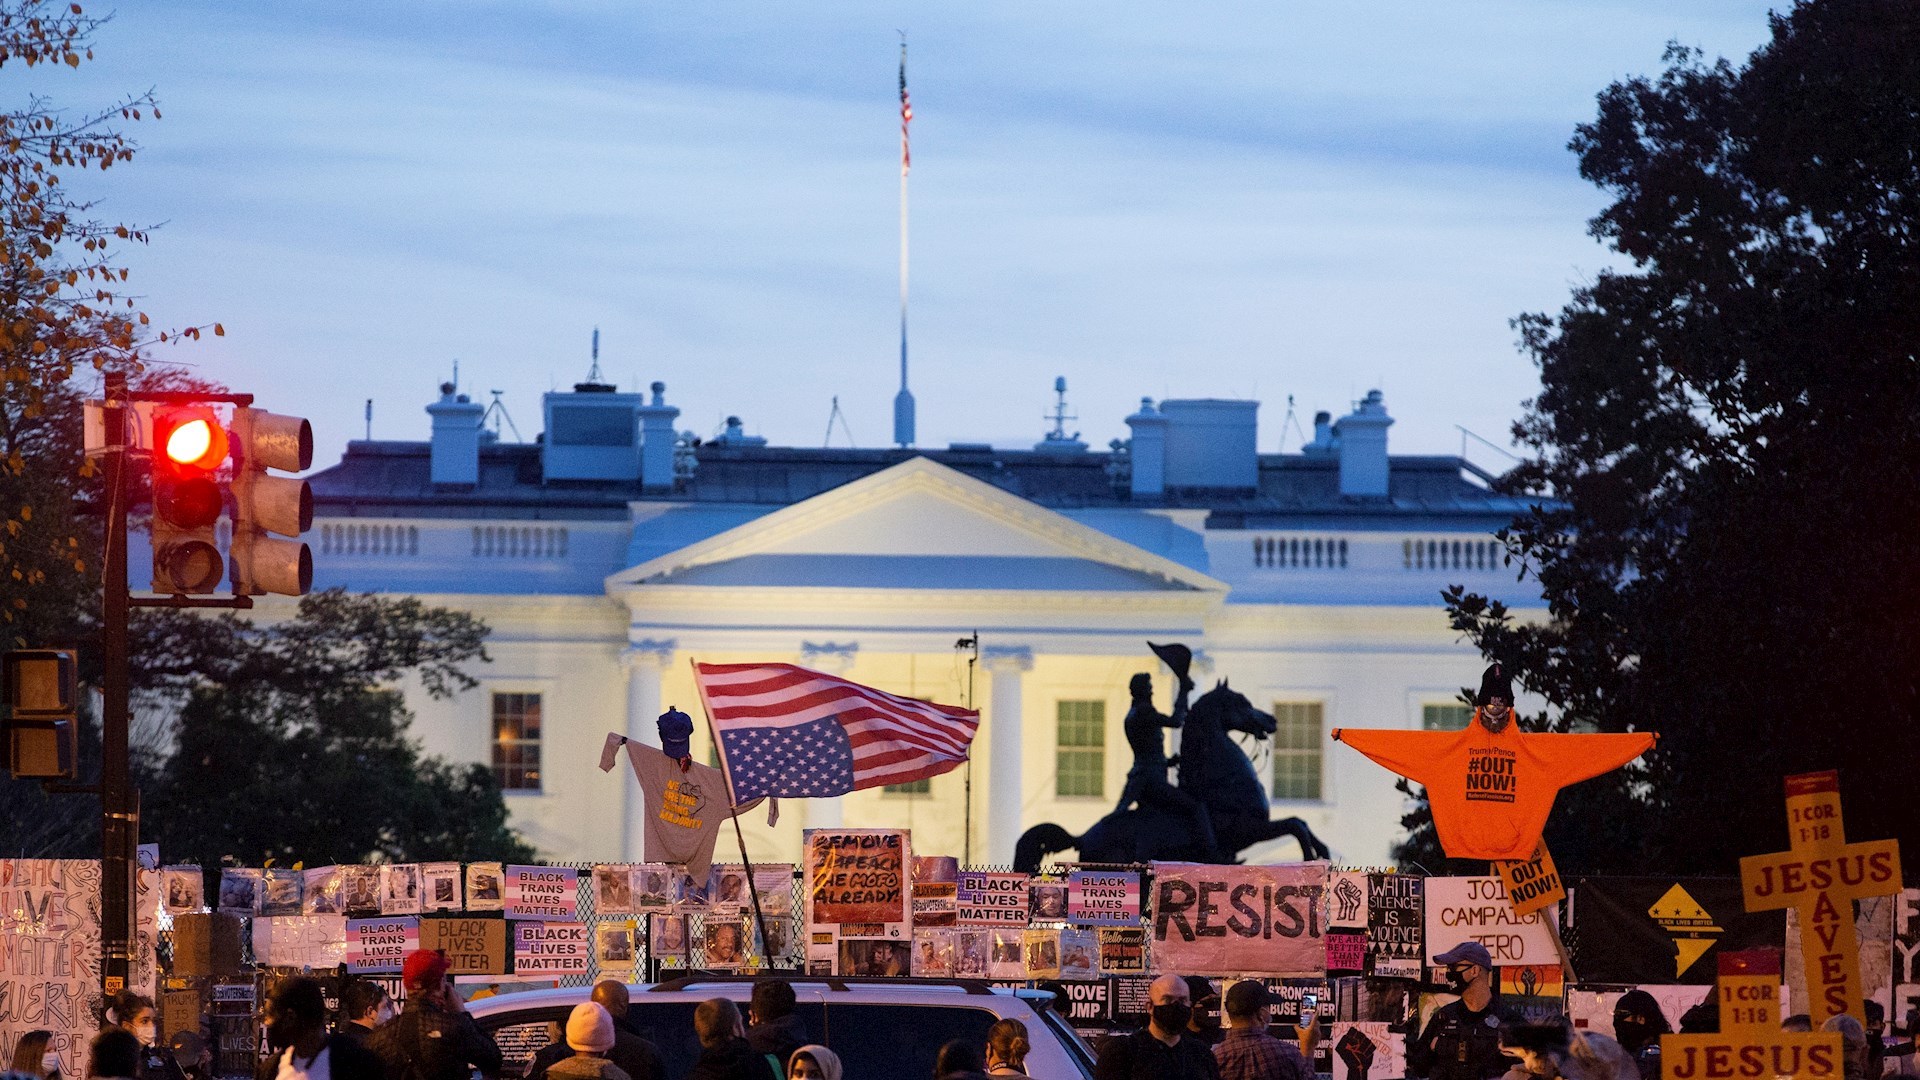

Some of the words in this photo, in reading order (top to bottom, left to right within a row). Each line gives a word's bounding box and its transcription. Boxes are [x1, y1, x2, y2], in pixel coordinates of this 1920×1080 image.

[1468, 756, 1516, 775] #OUT
[1467, 774, 1516, 792] NOW!
[1800, 828, 1830, 843] 1:18
[1511, 858, 1544, 883] OUT
[1755, 852, 1893, 897] JESUS
[519, 873, 565, 883] BLACK
[850, 873, 898, 888] MOFO
[1081, 878, 1126, 887] BLACK
[519, 883, 565, 893] TRANS
[965, 879, 1024, 892] BLACK
[1370, 878, 1420, 897] WHITE
[1467, 880, 1508, 900] JOI
[1511, 873, 1558, 905] NOW!
[522, 895, 560, 904] LIVES
[972, 895, 1018, 906] LIVES
[1081, 889, 1126, 898] TRANS
[1084, 900, 1123, 909] LIVES
[1370, 896, 1420, 910] SILENCE
[2, 890, 83, 939] LIVES
[513, 906, 568, 916] MATTER
[959, 909, 1025, 921] MATTER
[1076, 911, 1131, 921] MATTER
[1154, 880, 1324, 942] RESIST
[1385, 911, 1399, 924] IS
[360, 924, 405, 934] BLACK
[438, 921, 487, 937] BLACK
[523, 928, 582, 940] BLACK
[1368, 926, 1420, 943] VIOLENCE
[360, 935, 406, 945] TRANS
[438, 938, 485, 951] LIVES
[1328, 935, 1343, 943] WE
[1346, 936, 1366, 944] ARE
[364, 947, 403, 956] LIVES
[530, 944, 577, 954] LIVES
[0, 934, 94, 979] MATTER
[446, 954, 489, 969] TTER
[518, 958, 584, 969] MATTER
[1383, 967, 1399, 976] BLACK
[1062, 984, 1106, 1000] MOVE
[1724, 987, 1732, 1001] 1
[1069, 1003, 1100, 1018] UMP
[1270, 1002, 1297, 1015] BUSE
[1733, 1008, 1768, 1023] 1:18
[1333, 1022, 1360, 1038] BLCK
[222, 1036, 255, 1050] LIVES
[1673, 1045, 1834, 1079] JESUS
